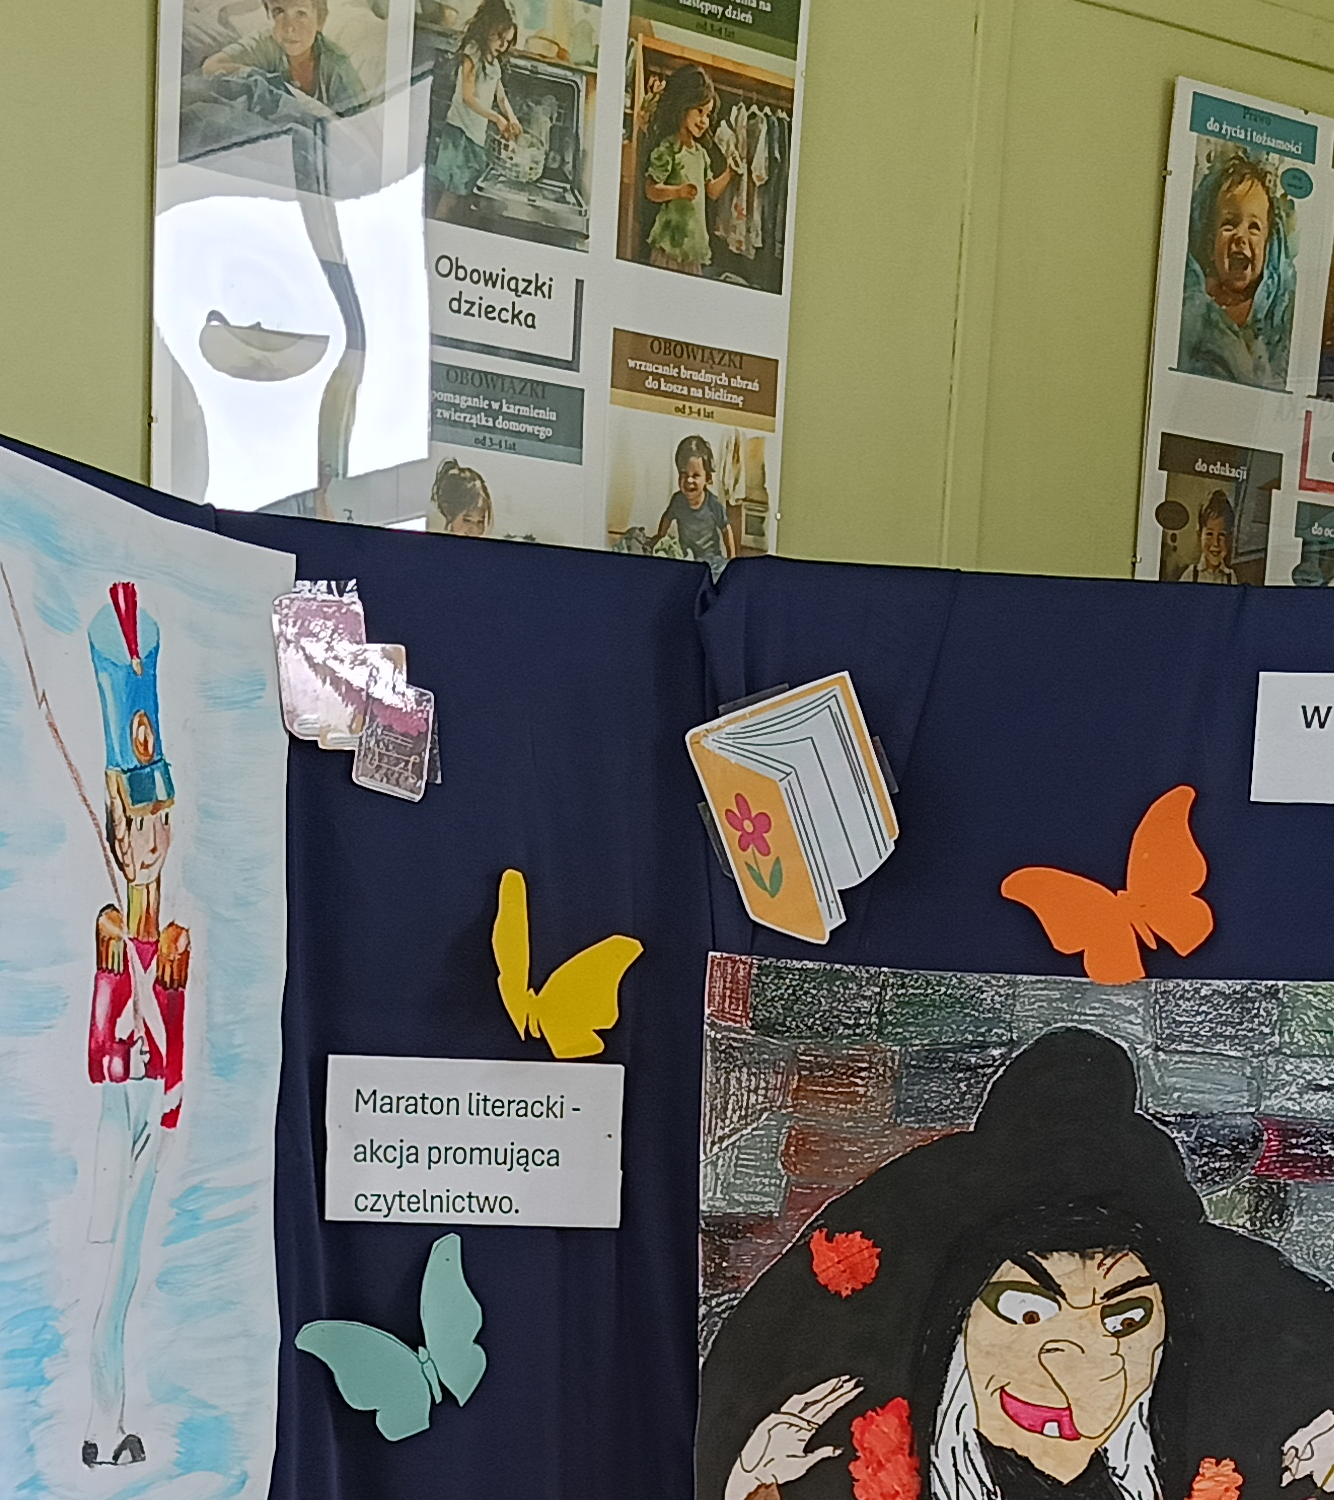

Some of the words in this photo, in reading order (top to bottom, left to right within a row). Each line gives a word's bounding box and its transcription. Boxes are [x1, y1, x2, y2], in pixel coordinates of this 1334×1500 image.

[725, 4, 753, 24] dzień
[1206, 117, 1219, 132] do
[1221, 120, 1245, 140] życia
[1252, 131, 1303, 154] tożsamości
[434, 254, 554, 300] Obowiązki
[448, 290, 537, 330] dziecka
[649, 338, 744, 370] OBOWIĄZKI
[627, 358, 679, 378] wrzucanie
[680, 364, 729, 387] brudnych
[730, 375, 760, 392] ubrań
[645, 376, 658, 389] do
[660, 378, 688, 396] kosza
[690, 386, 703, 398] na
[436, 407, 494, 428] zwierzątka
[495, 416, 553, 440] domowego
[491, 400, 501, 411] w
[502, 399, 557, 422] karmieniu
[674, 404, 686, 415] od
[703, 408, 715, 419] lat
[474, 436, 486, 446] od
[504, 439, 517, 451] lat
[1195, 458, 1208, 473] do
[1209, 461, 1247, 482] edukacji
[1312, 522, 1323, 536] do
[1301, 705, 1333, 729] W
[354, 1088, 461, 1117] Maraton
[468, 1092, 565, 1119] literacki
[353, 1138, 419, 1170] akcja
[427, 1141, 560, 1173] promująca
[353, 1188, 520, 1218] czytelnictwo.
